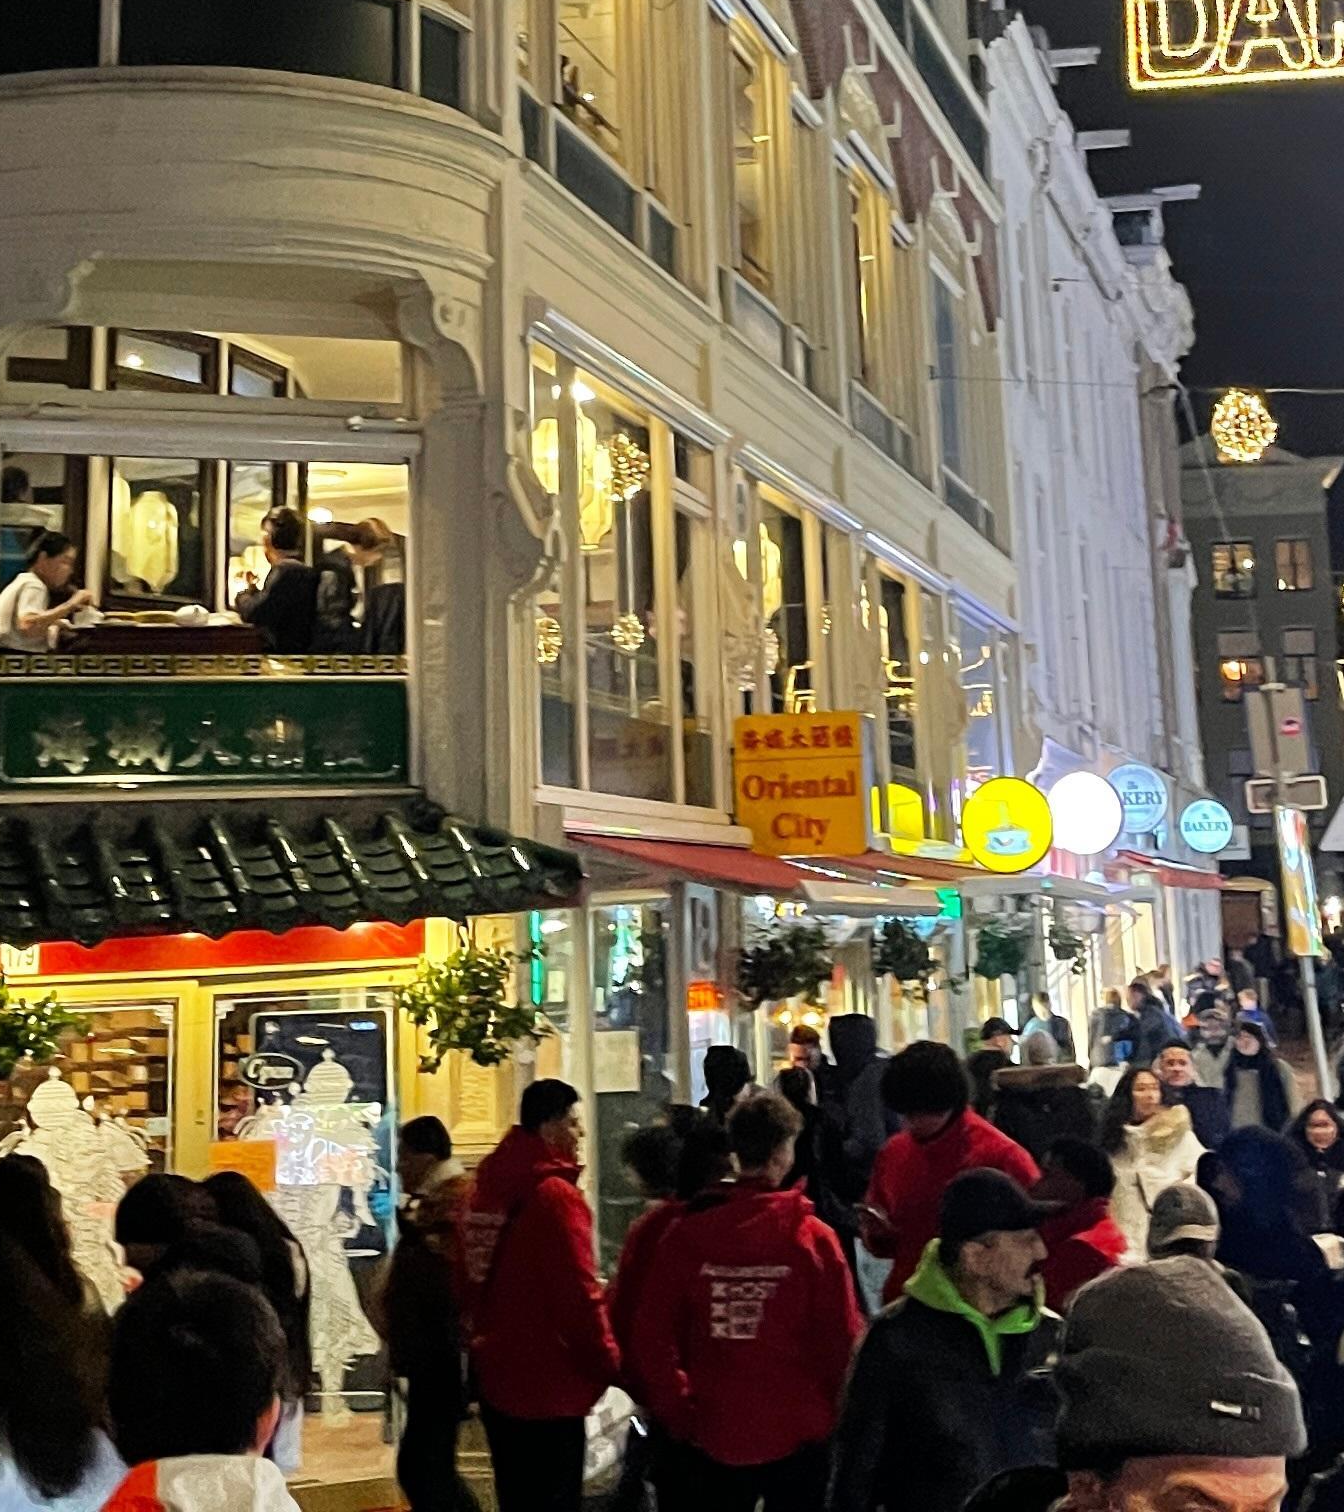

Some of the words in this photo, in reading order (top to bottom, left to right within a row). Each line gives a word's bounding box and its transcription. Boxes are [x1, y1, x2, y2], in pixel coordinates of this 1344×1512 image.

[742, 770, 857, 801] Oriental
[1121, 790, 1164, 806] KERY
[771, 812, 831, 846] City
[1184, 821, 1230, 833] BAKERY
